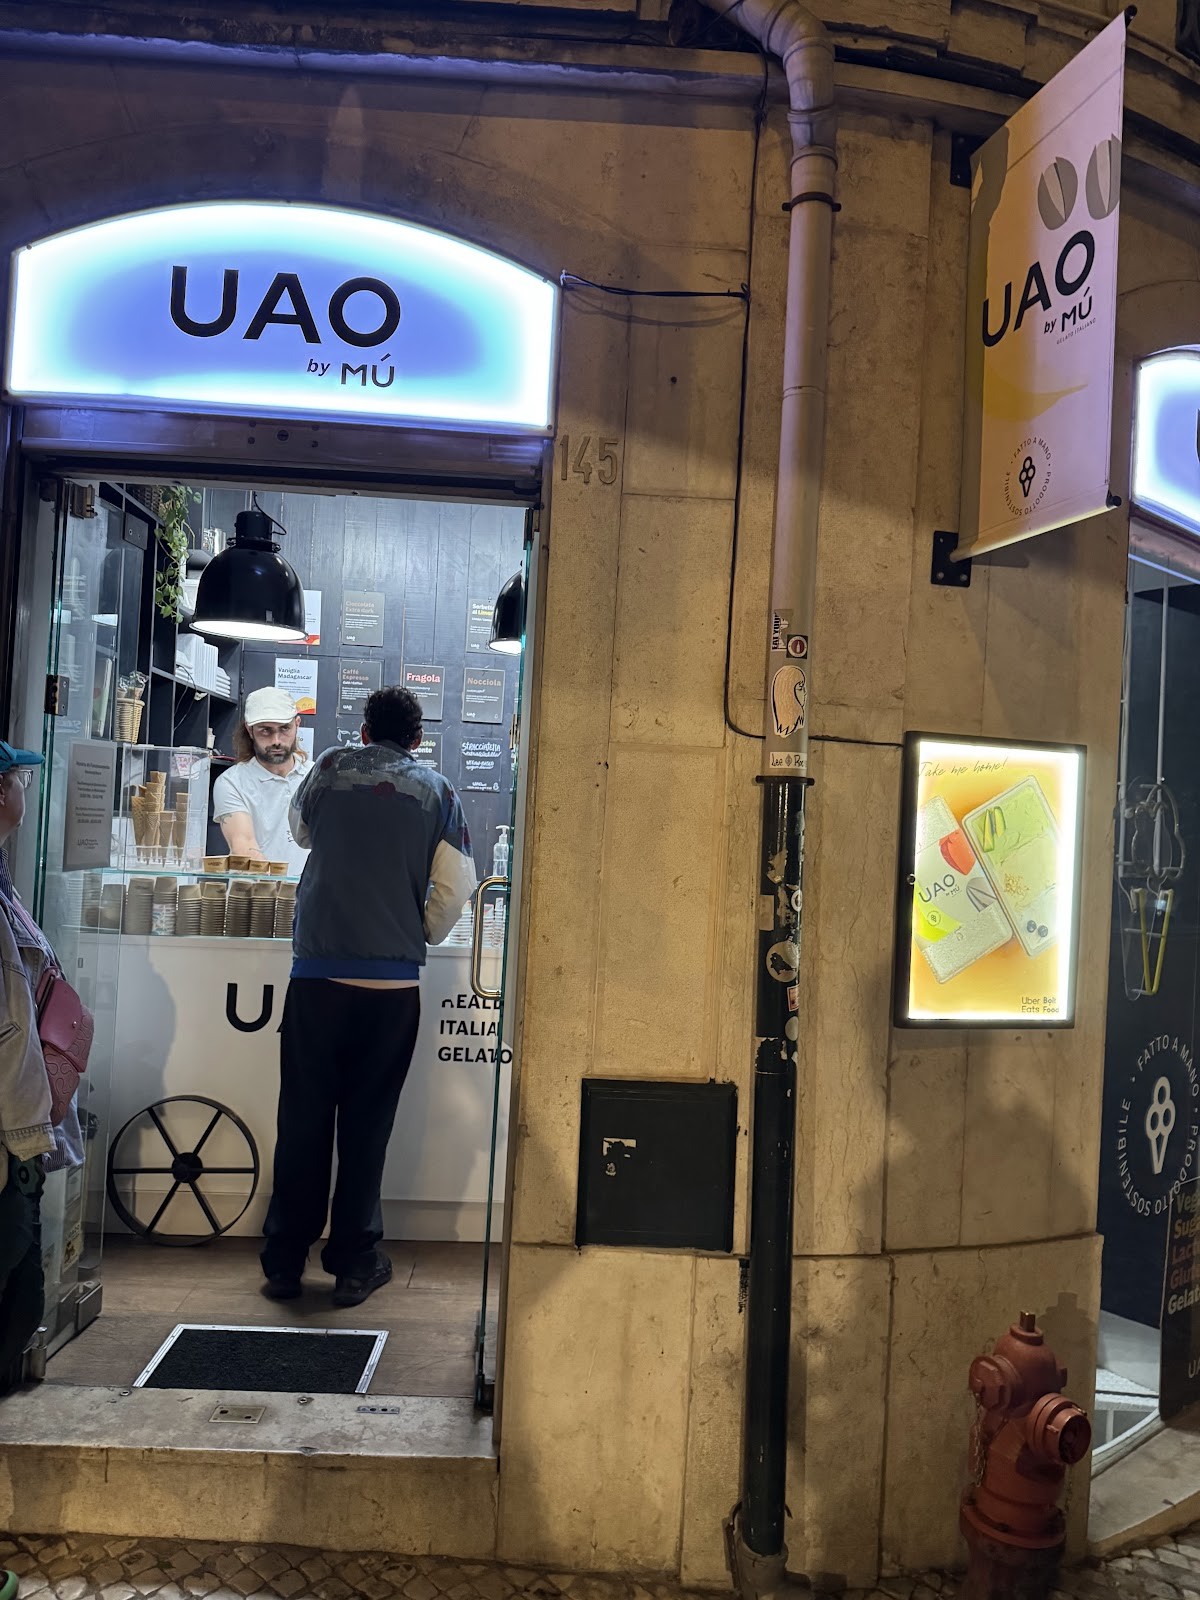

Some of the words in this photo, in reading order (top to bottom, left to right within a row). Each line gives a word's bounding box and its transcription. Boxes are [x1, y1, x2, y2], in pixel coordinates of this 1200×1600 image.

[170, 265, 400, 348] UAO
[982, 230, 1095, 347] UAO
[1043, 318, 1057, 334] by
[1061, 286, 1092, 333] MÚ
[1056, 331, 1073, 345] GELATO
[307, 358, 330, 377] by
[340, 352, 395, 388] MÚ
[559, 434, 618, 485] 145
[1013, 438, 1032, 458] FATTO
[1038, 438, 1052, 460] MANO
[1004, 471, 1022, 516] SOSTENIBILE
[1025, 471, 1052, 515] PRODOTTO
[406, 672, 441, 684] Fragola
[467, 677, 502, 687] Nocciola
[919, 761, 946, 777] Take
[951, 766, 968, 776] me
[973, 756, 1008, 773] home!
[919, 874, 955, 903] UAO
[1021, 996, 1041, 1005] Uber
[1043, 996, 1057, 1006] Bolt
[438, 1046, 513, 1064] GELATO
[1137, 1034, 1170, 1072] FATTO
[1172, 1037, 1179, 1052] A
[1180, 1044, 1200, 1097] MANO
[1117, 1098, 1152, 1217] SOSTENIBILE
[1155, 1125, 1199, 1215] PRODOTTO
